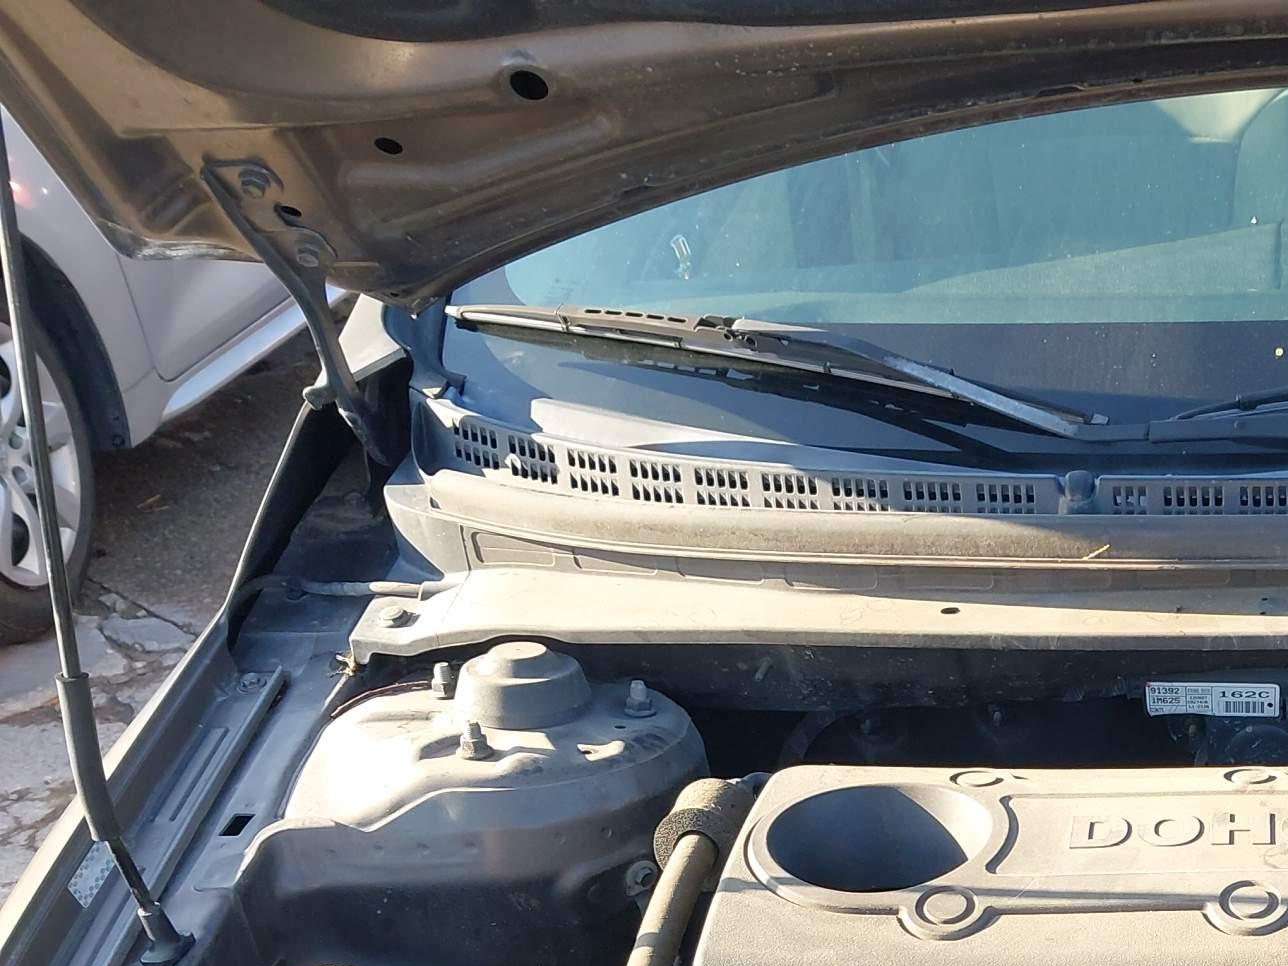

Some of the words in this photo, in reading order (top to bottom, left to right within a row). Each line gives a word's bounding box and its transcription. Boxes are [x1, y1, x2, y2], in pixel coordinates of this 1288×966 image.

[1150, 687, 1180, 695] 91392
[1219, 690, 1271, 699] 162C
[1151, 696, 1181, 705] 1M625
